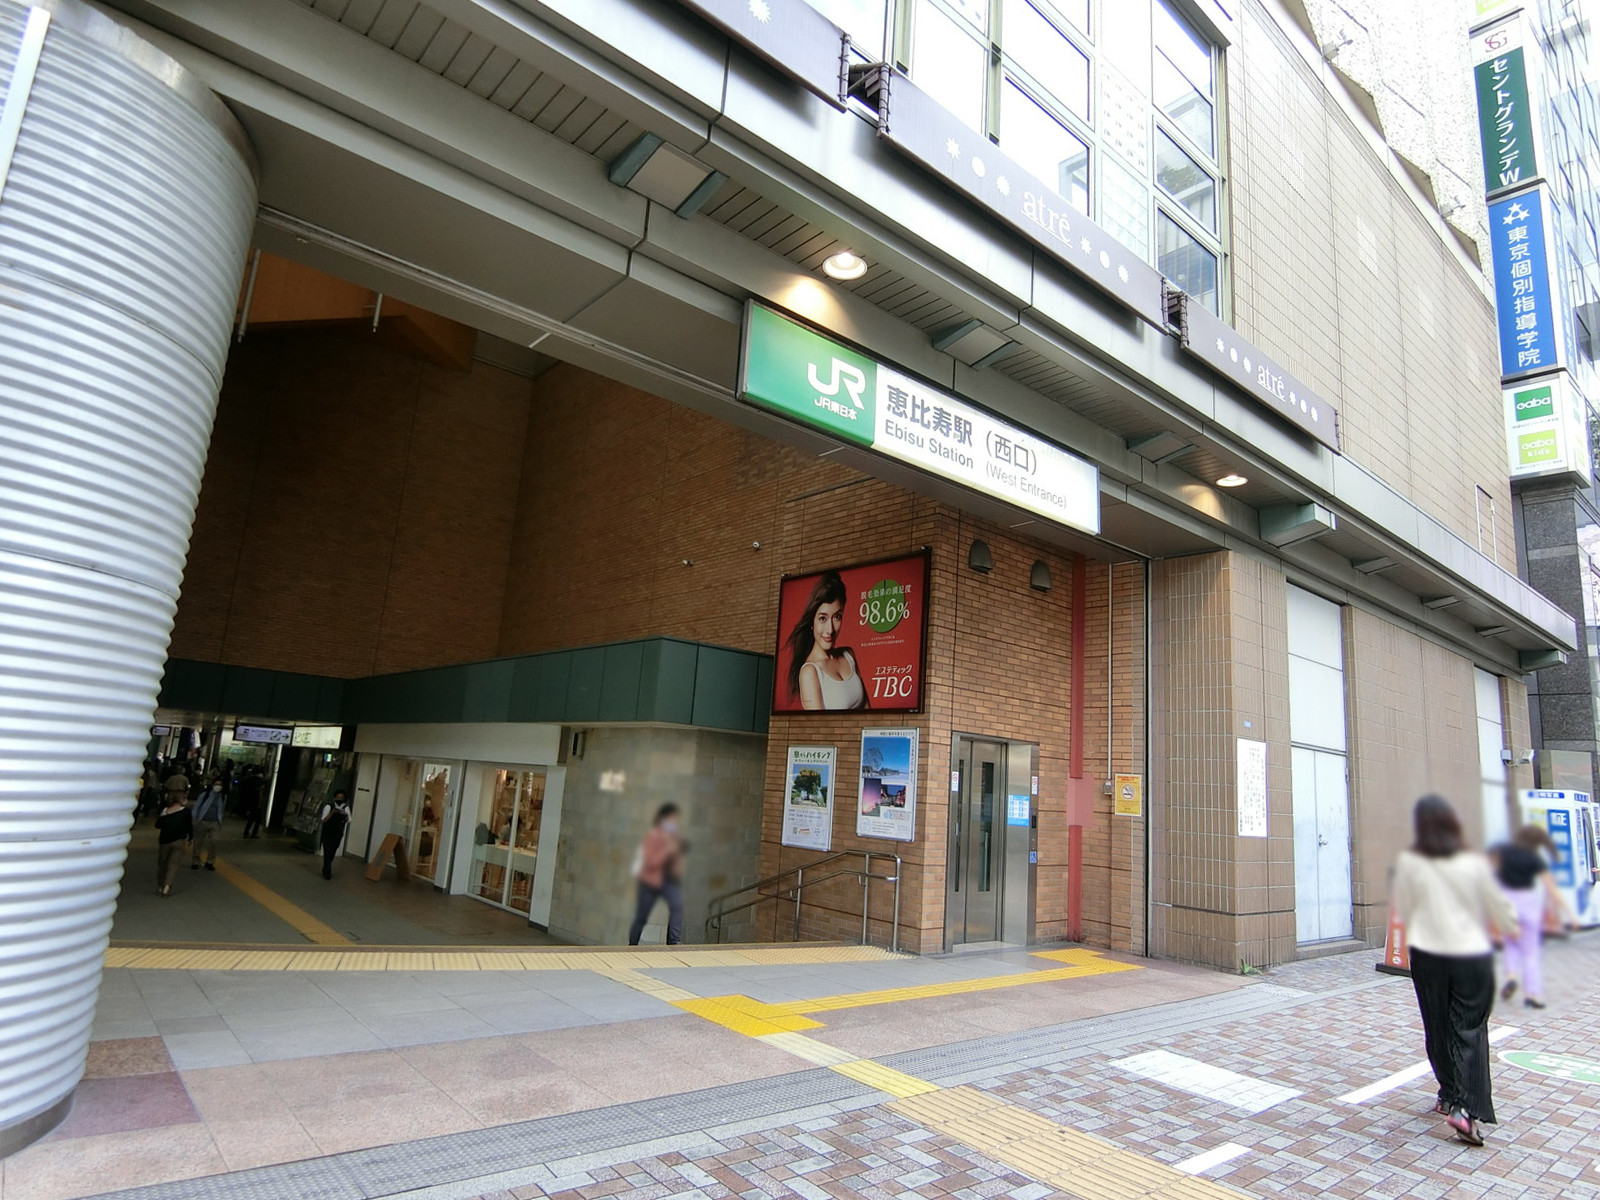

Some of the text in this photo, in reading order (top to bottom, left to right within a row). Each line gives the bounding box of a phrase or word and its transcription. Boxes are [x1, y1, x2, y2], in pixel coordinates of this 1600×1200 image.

[1489, 58, 1520, 187] セントグランデW
[1021, 189, 1073, 246] atré
[1507, 225, 1541, 368] 東京個別指導学院
[807, 356, 867, 410] JR
[1257, 362, 1286, 400] atré
[813, 395, 858, 422] JR東日本
[886, 384, 973, 448] 恵比寿駅
[885, 420, 1068, 510] Ebisu Station (West Entrance)
[859, 598, 910, 626] 98.6%
[871, 675, 913, 698] TBC
[875, 664, 913, 676] エステティック
